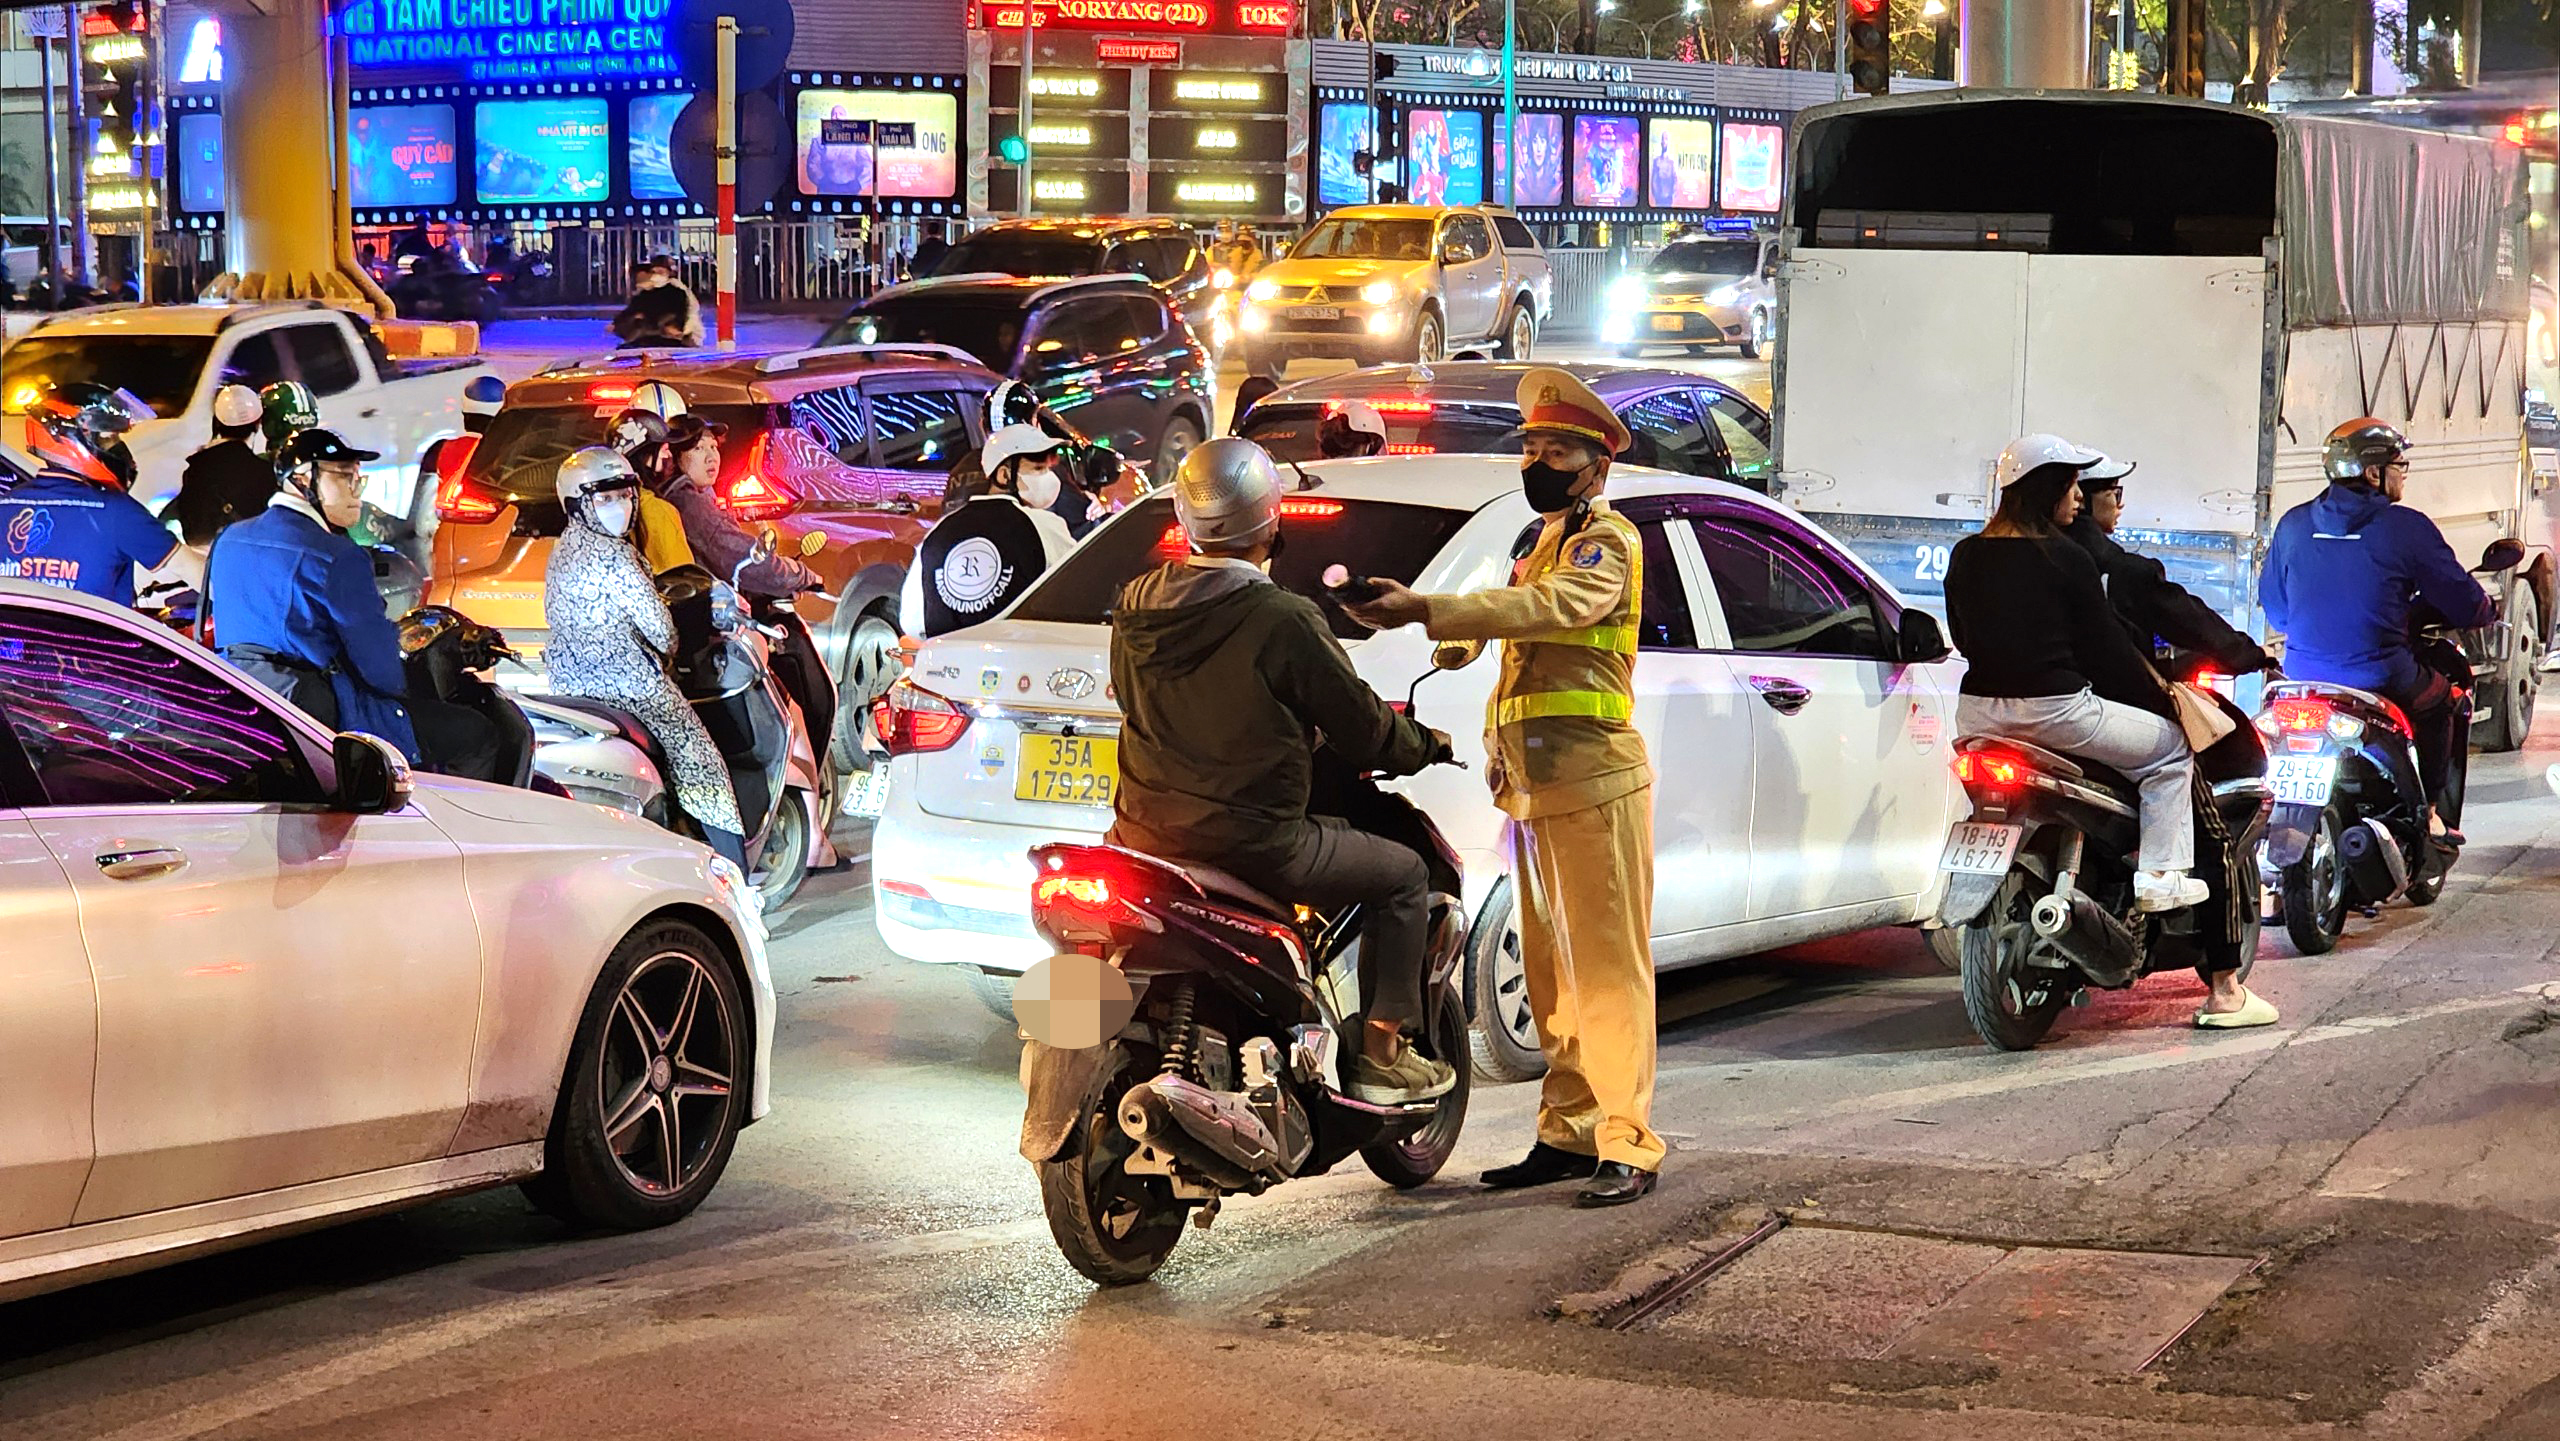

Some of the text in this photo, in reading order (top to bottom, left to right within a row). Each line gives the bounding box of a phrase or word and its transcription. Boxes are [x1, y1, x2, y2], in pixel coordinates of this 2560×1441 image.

[1057, 0, 1207, 26] NORYANG (2D)
[353, 35, 490, 63] NATIONAL
[498, 29, 604, 54] CINEMA
[1101, 45, 1130, 57] PHIM
[922, 131, 946, 153] ONG
[1049, 739, 1092, 768] 35A
[2276, 759, 2324, 779] 29-E2
[1031, 769, 1112, 801] 179.29
[1960, 825, 2009, 848] 18-H3
[1950, 849, 2002, 870] 4627
